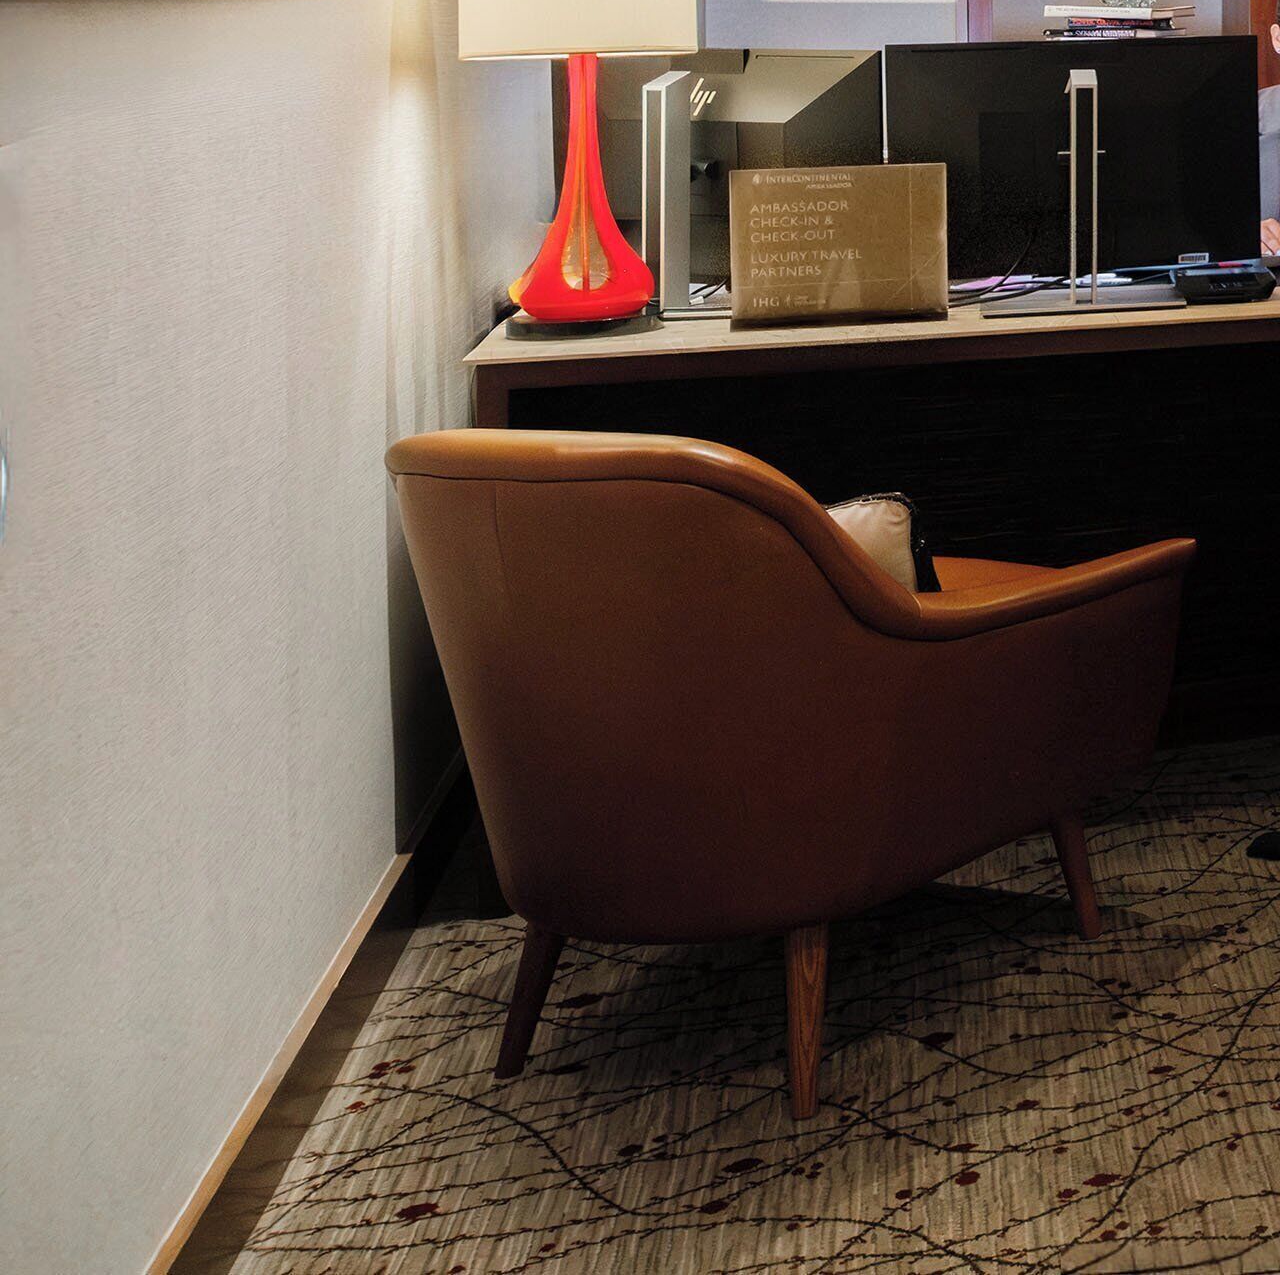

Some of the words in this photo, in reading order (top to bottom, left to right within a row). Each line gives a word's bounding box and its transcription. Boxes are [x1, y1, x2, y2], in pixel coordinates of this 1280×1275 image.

[766, 173, 852, 184] INTERCONTINENTAL
[750, 200, 849, 214] AMBASSADOR
[750, 216, 819, 228] CHECK-IN
[824, 215, 834, 225] &
[750, 229, 836, 243] CHECK-OUT
[751, 250, 806, 264] LUXURY
[812, 248, 863, 261] TRAVEL
[751, 265, 822, 278] PARTNERS
[753, 297, 780, 308] IHG
